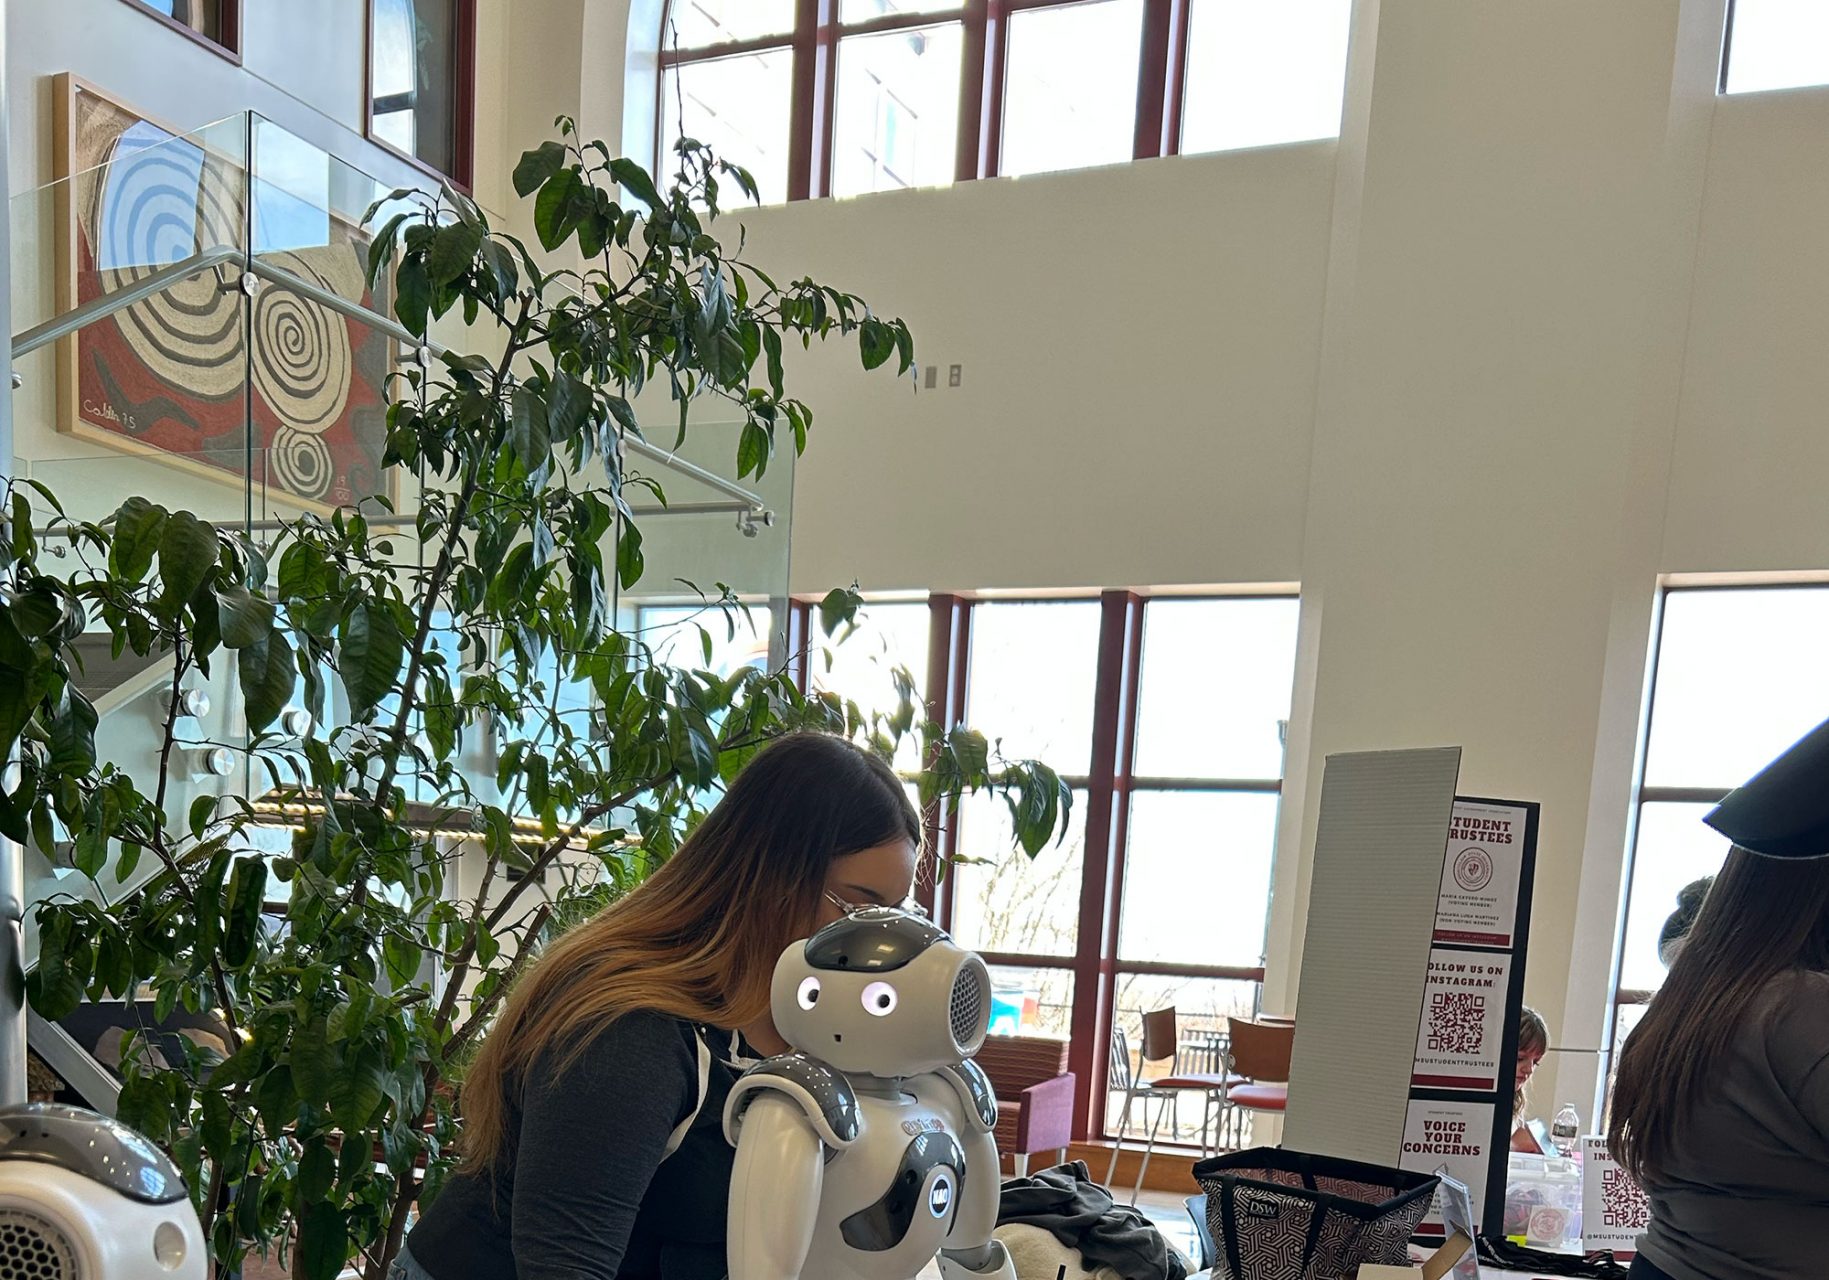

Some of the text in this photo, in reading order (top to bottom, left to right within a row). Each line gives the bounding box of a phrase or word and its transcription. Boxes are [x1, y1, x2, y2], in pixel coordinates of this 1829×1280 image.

[1453, 816, 1512, 832] TUDENT
[1449, 828, 1513, 844] RUSTEES
[1428, 963, 1503, 976] OLLOW US ON
[1415, 1058, 1494, 1067] MSUSTUDENTTRUSTEES
[1424, 1121, 1466, 1132] VOICE
[1424, 1132, 1462, 1144] YOUR
[1588, 1140, 1607, 1148] FOL
[1403, 1143, 1481, 1156] CONCERNS
[933, 1188, 949, 1204] NAO
[1250, 1201, 1277, 1215] DSW
